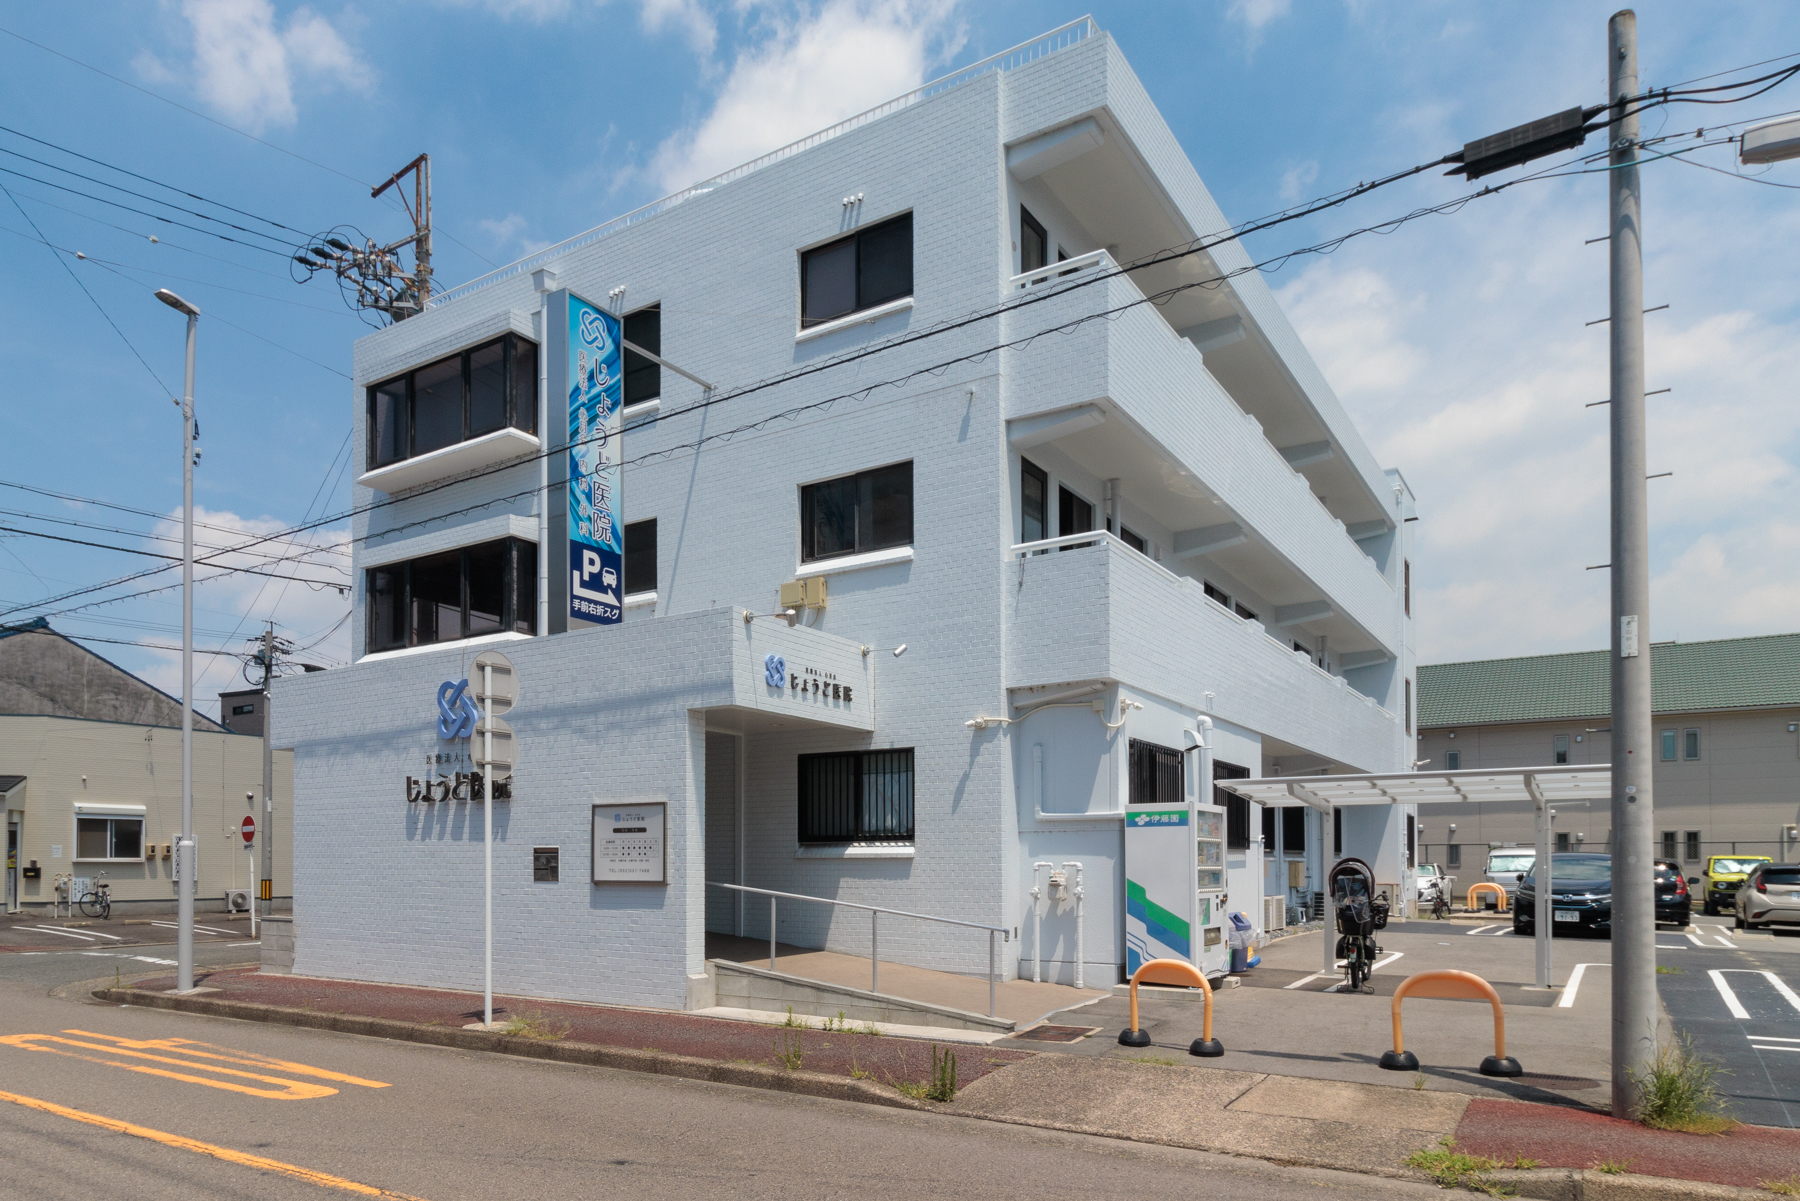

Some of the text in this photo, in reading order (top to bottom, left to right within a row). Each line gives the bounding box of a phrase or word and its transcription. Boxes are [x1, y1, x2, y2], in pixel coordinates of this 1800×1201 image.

[591, 356, 613, 545] じょうど医院
[578, 458, 589, 537] 内科・外科
[583, 549, 601, 581] P
[572, 598, 620, 620] 手前右折スグ
[1150, 814, 1180, 824] 伊藤園
